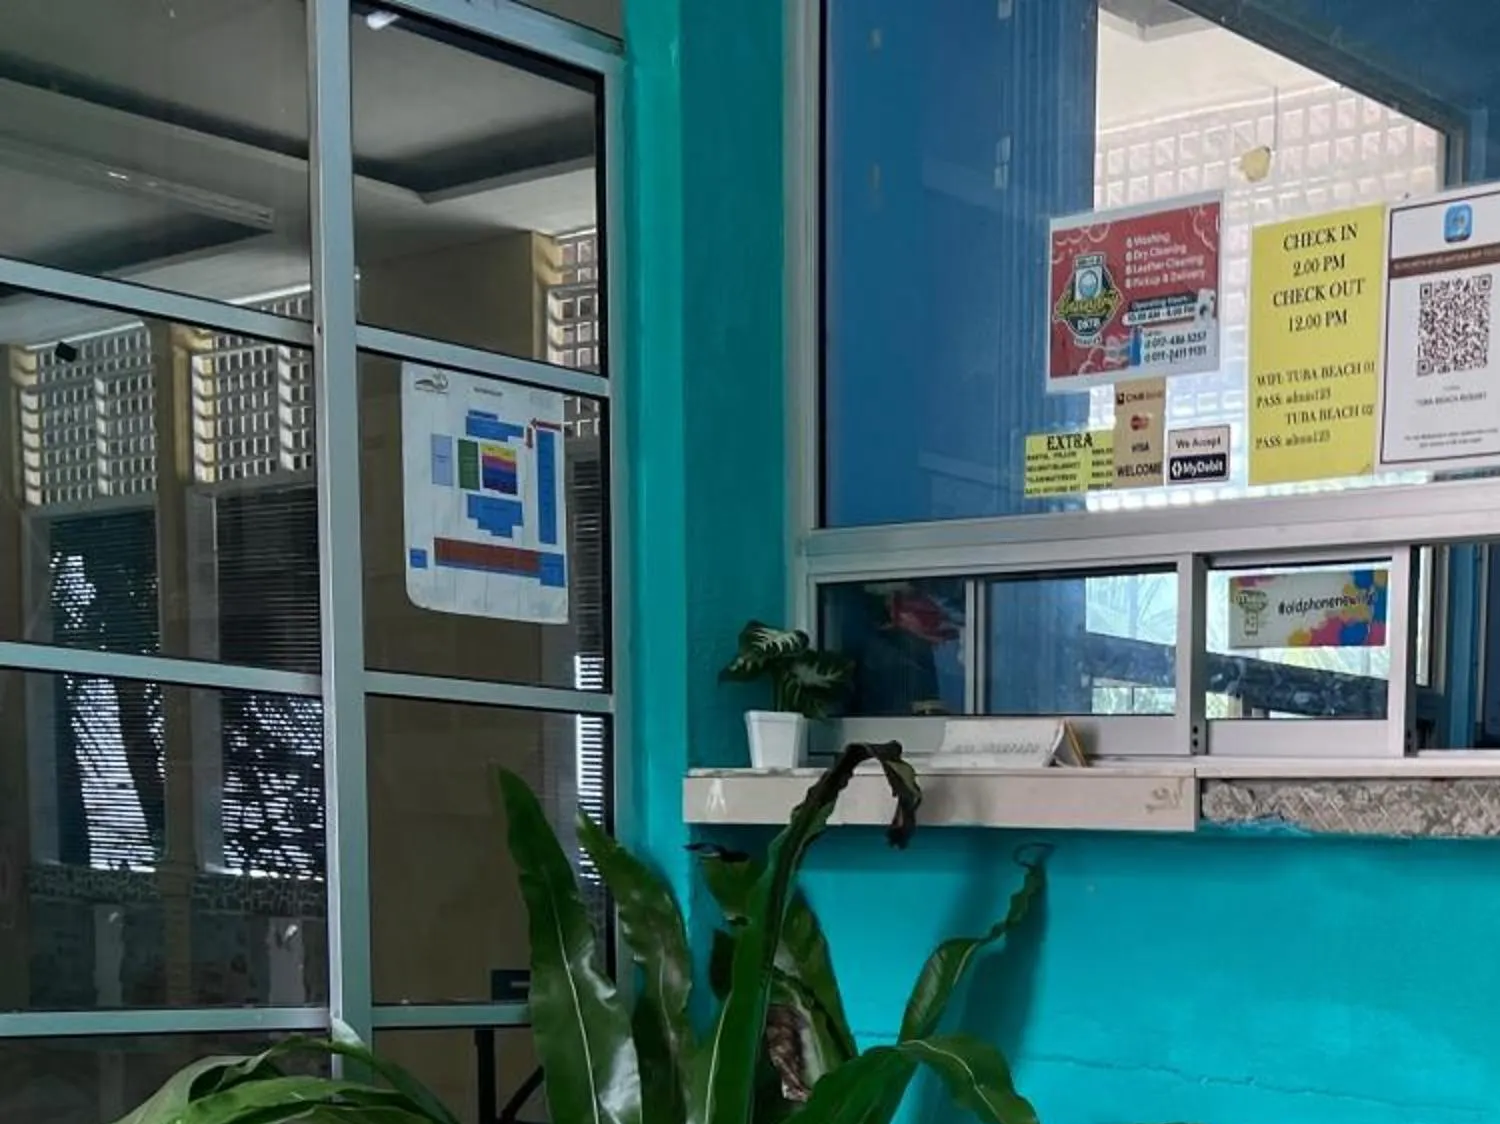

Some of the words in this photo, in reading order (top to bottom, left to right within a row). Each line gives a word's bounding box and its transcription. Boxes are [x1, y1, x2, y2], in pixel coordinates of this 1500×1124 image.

[1283, 227, 1336, 252] CHECK
[1341, 222, 1358, 242] IN
[1293, 257, 1320, 278] 2.00
[1323, 253, 1345, 272] PM
[1273, 284, 1326, 307] CHECK
[1329, 277, 1366, 299] OUT
[1289, 312, 1321, 333] 12.00
[1325, 308, 1347, 327] PM
[1286, 368, 1317, 382] TUBA
[1321, 362, 1361, 379] BEACH
[1285, 410, 1317, 425] TUBA
[1319, 404, 1360, 421] BEACH
[1047, 432, 1093, 451] EXTRA
[1176, 438, 1190, 449] We
[1192, 436, 1221, 449] Accept
[1117, 461, 1162, 477] WELCOME
[1183, 458, 1223, 477] MyDebit
